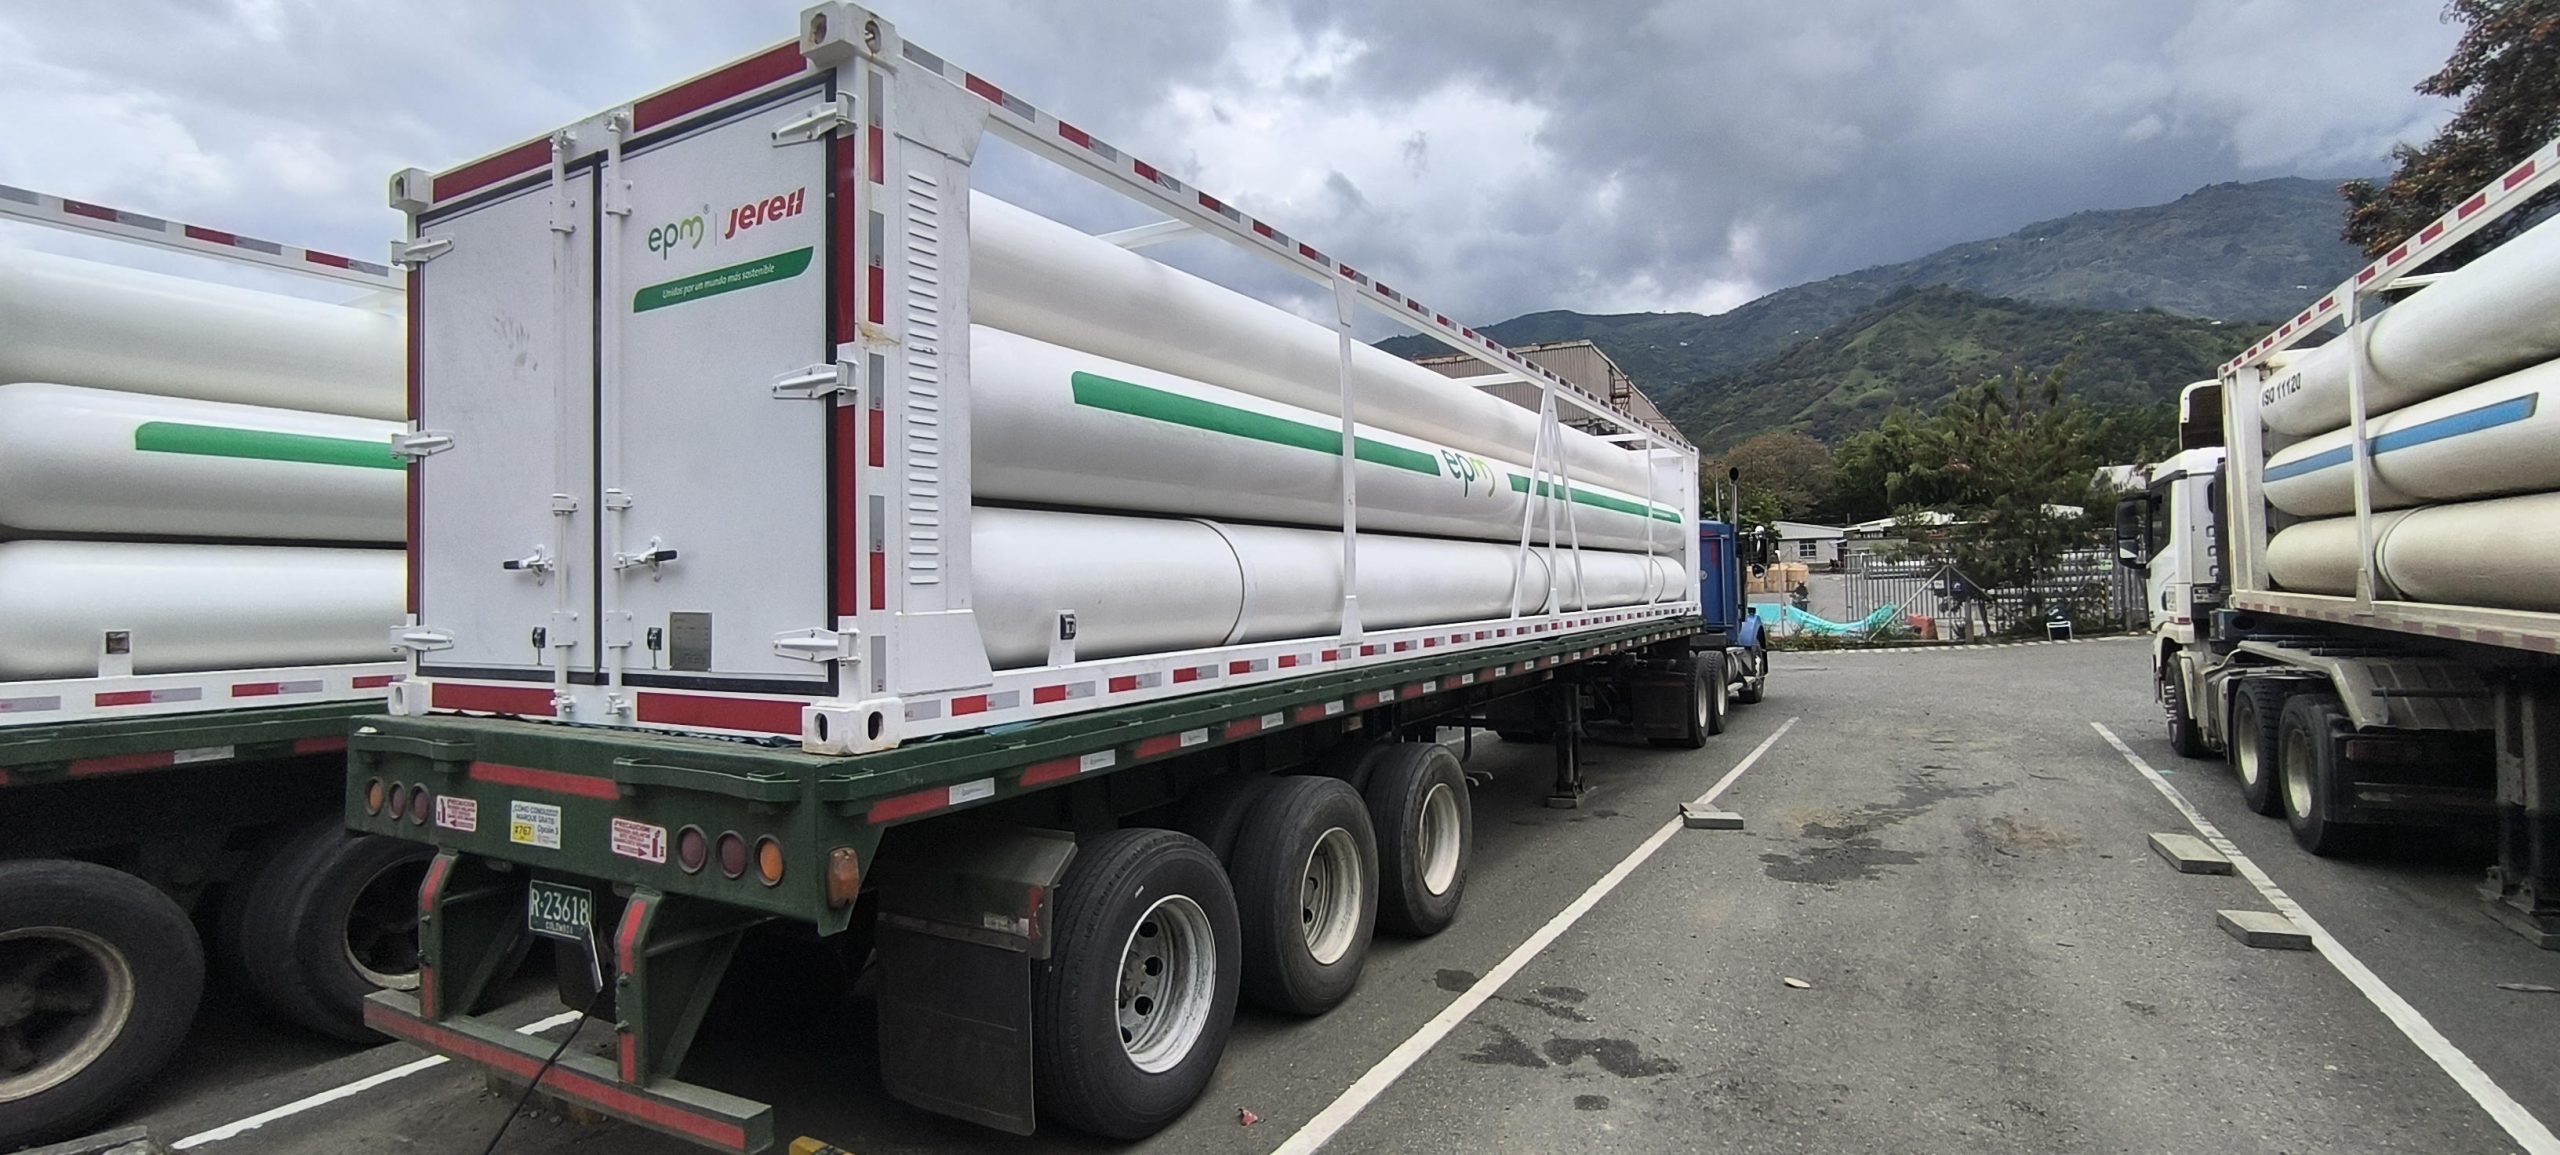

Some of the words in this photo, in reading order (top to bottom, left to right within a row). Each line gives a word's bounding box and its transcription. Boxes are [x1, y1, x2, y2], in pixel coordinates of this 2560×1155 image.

[648, 215, 704, 260] epm
[683, 284, 695, 296] por
[695, 282, 703, 291] un
[704, 275, 727, 288] mundo
[742, 264, 775, 280] sostenible
[2261, 386, 2275, 408] ISO
[2277, 372, 2301, 401] 11120
[1440, 449, 1496, 498] epm
